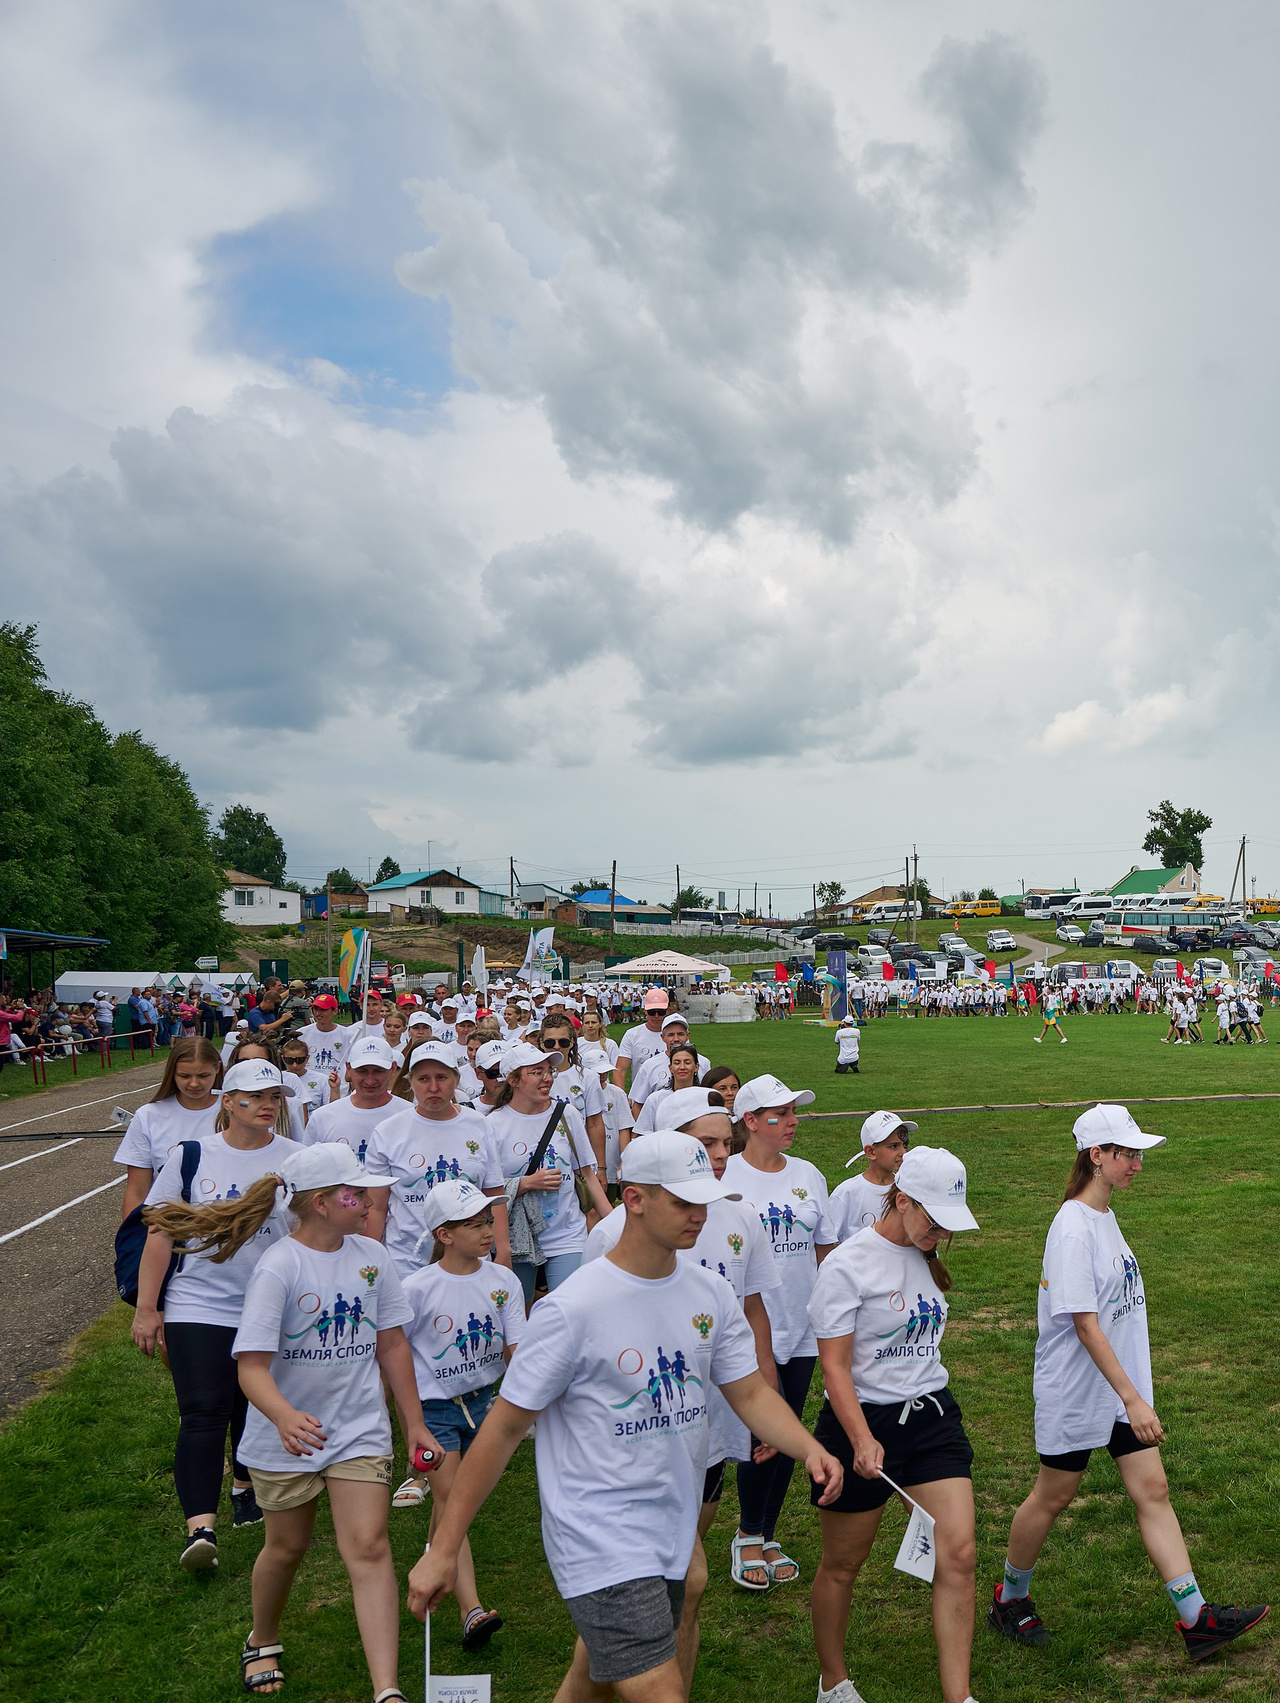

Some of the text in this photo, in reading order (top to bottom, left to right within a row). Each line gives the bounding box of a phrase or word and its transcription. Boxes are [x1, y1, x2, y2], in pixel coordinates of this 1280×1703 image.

[404, 1194, 425, 1203] ЗЕМ
[774, 1241, 809, 1253] СПОРТ
[282, 1342, 376, 1360] ЗЕМЛЯ СПОРТ
[874, 1346, 914, 1360] ЗЕМЛЯ
[435, 1361, 476, 1379] ЗЕМЛЯ
[615, 1415, 670, 1437] ЗЕМЛЯ
